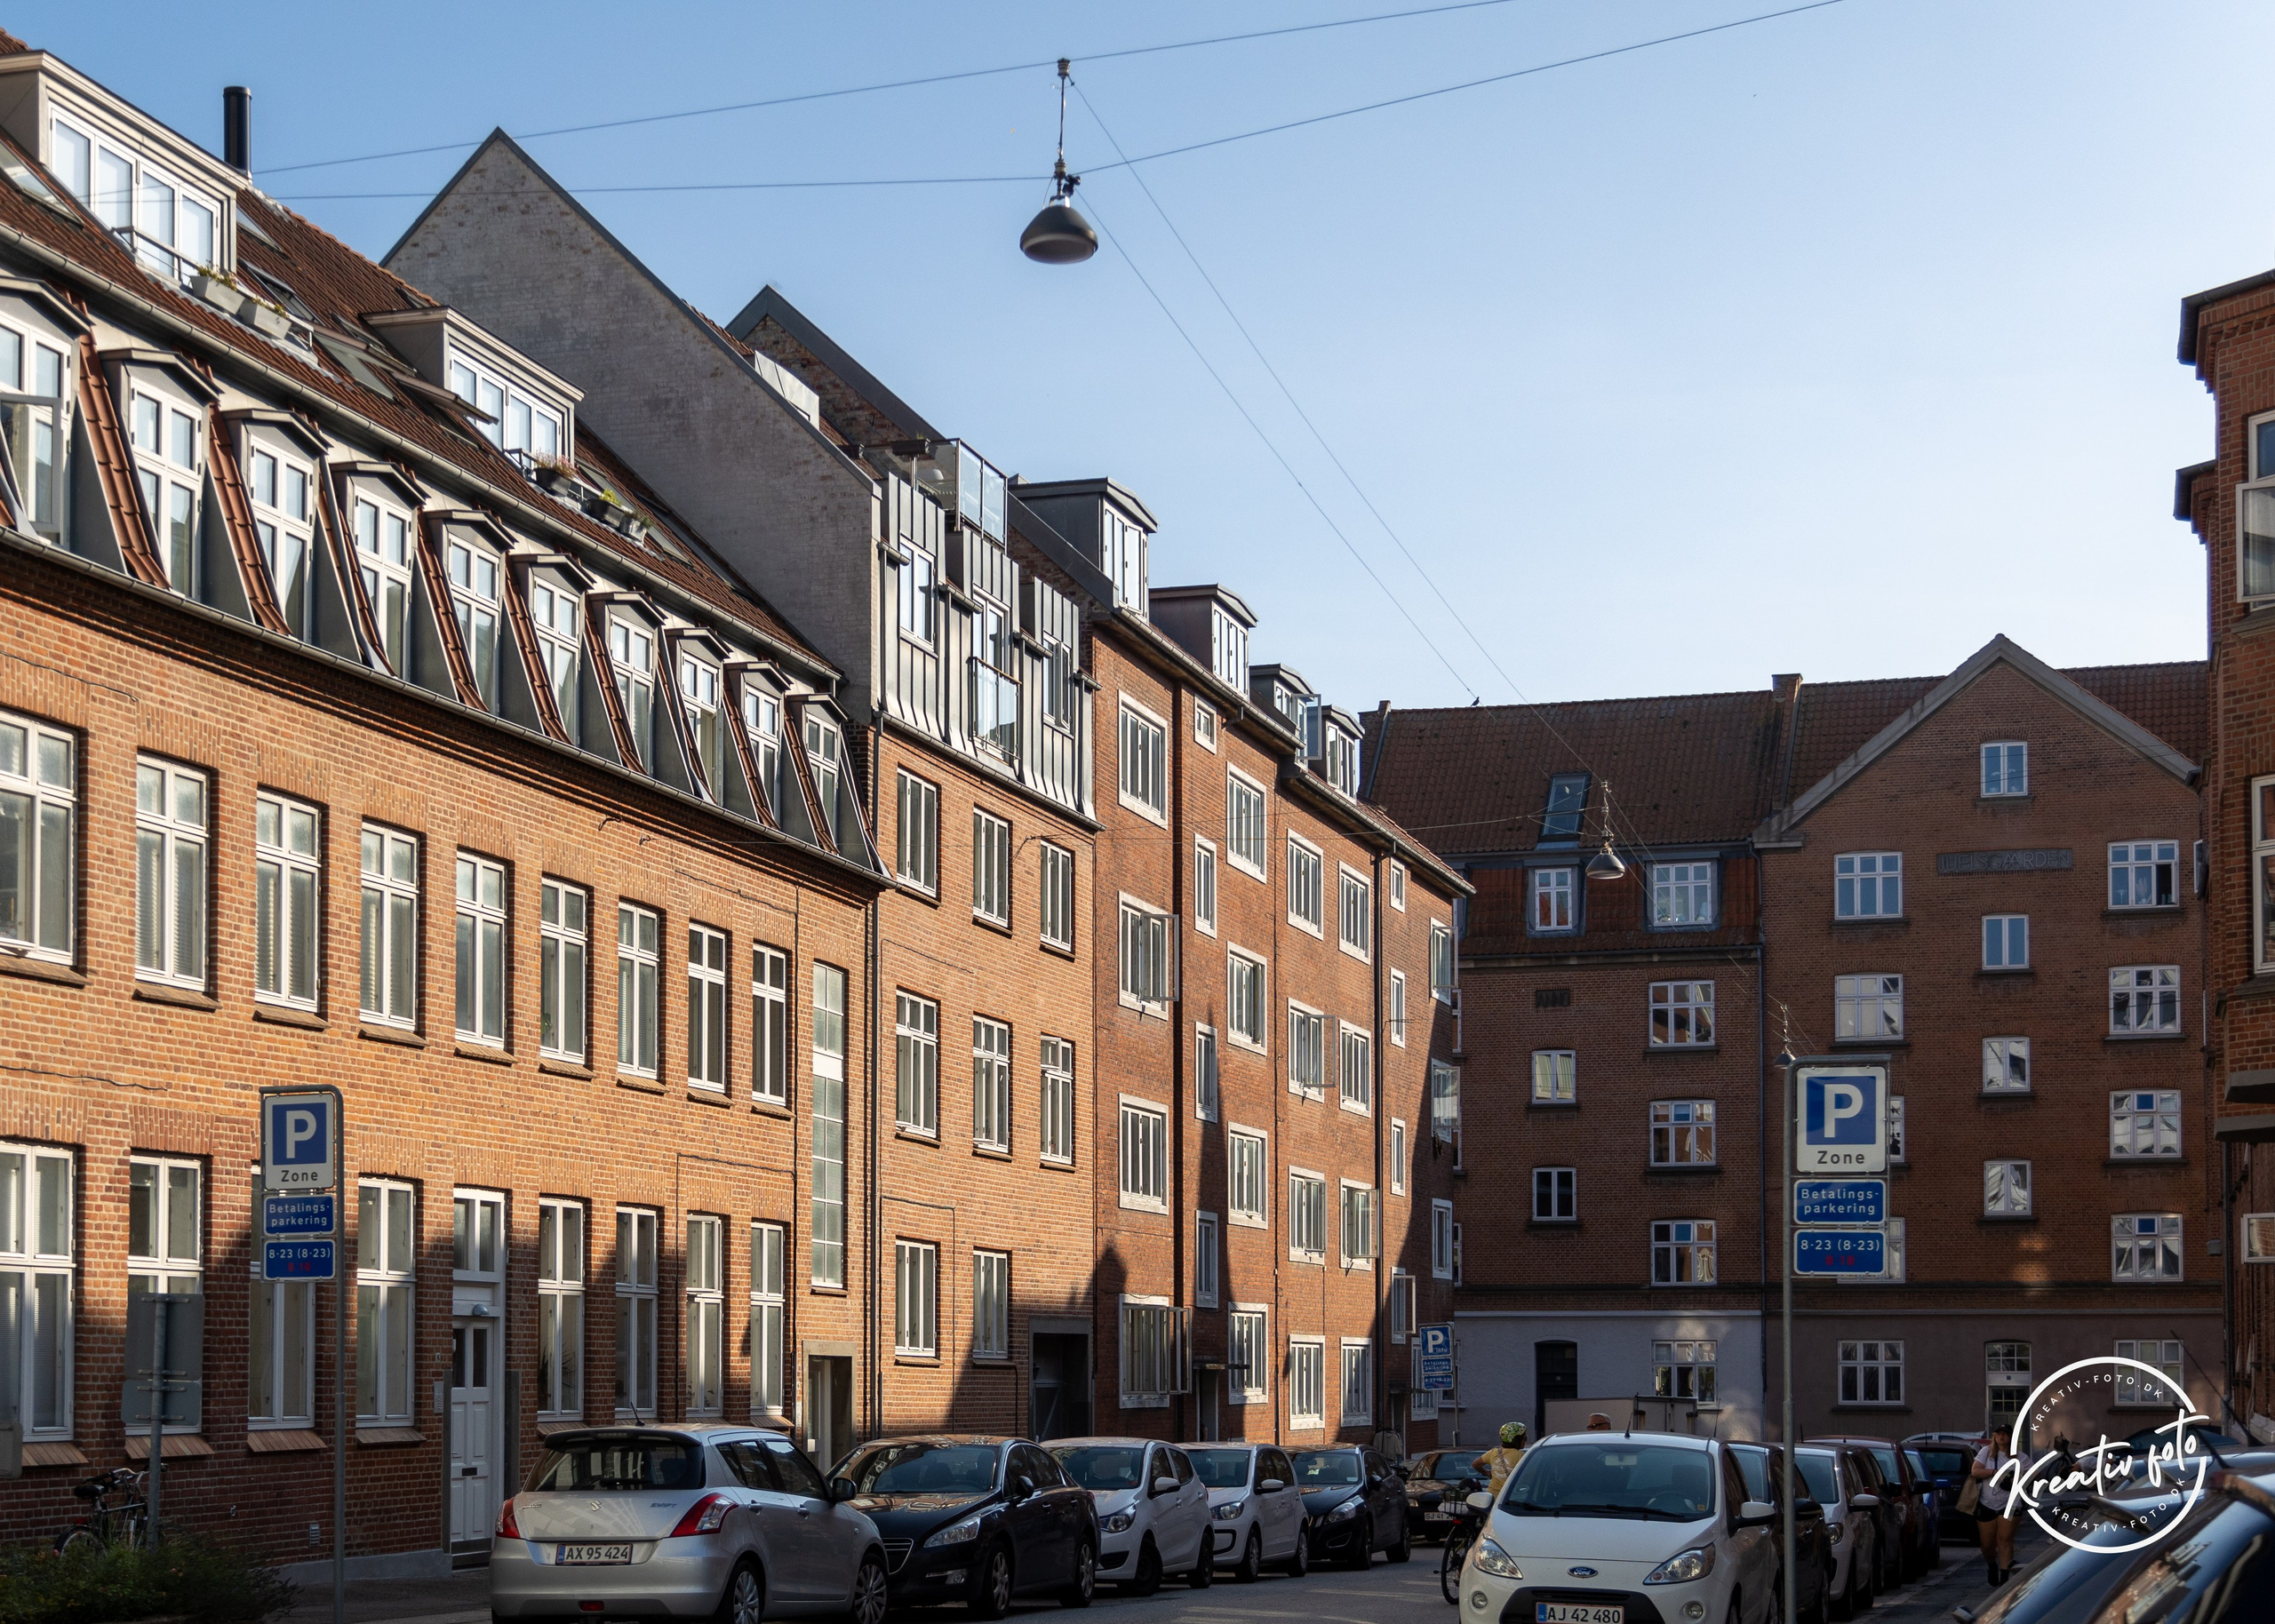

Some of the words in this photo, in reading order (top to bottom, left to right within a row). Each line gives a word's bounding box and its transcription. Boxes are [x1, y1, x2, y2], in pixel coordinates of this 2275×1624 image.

[1824, 1084, 1864, 1138] P
[285, 1110, 317, 1159] P
[1816, 1150, 1865, 1165] Zone
[281, 1169, 319, 1182] Zone
[1801, 1189, 1880, 1201] Betalings-
[269, 1204, 330, 1215] Betalings-
[1804, 1203, 1876, 1215] parkering
[271, 1216, 328, 1228] parkering
[1800, 1239, 1832, 1251] 8-23
[1838, 1238, 1880, 1252] (8-23)
[268, 1248, 293, 1259] 8-23
[297, 1247, 331, 1259] (8-23)
[1426, 1330, 1444, 1354] P
[566, 1547, 584, 1560] AX
[587, 1547, 602, 1560] 95
[604, 1546, 629, 1559] 424
[1573, 1567, 1592, 1576] Ford
[1547, 1606, 1567, 1621] AJ
[1570, 1608, 1589, 1622] 42
[1592, 1609, 1621, 1624] 480
